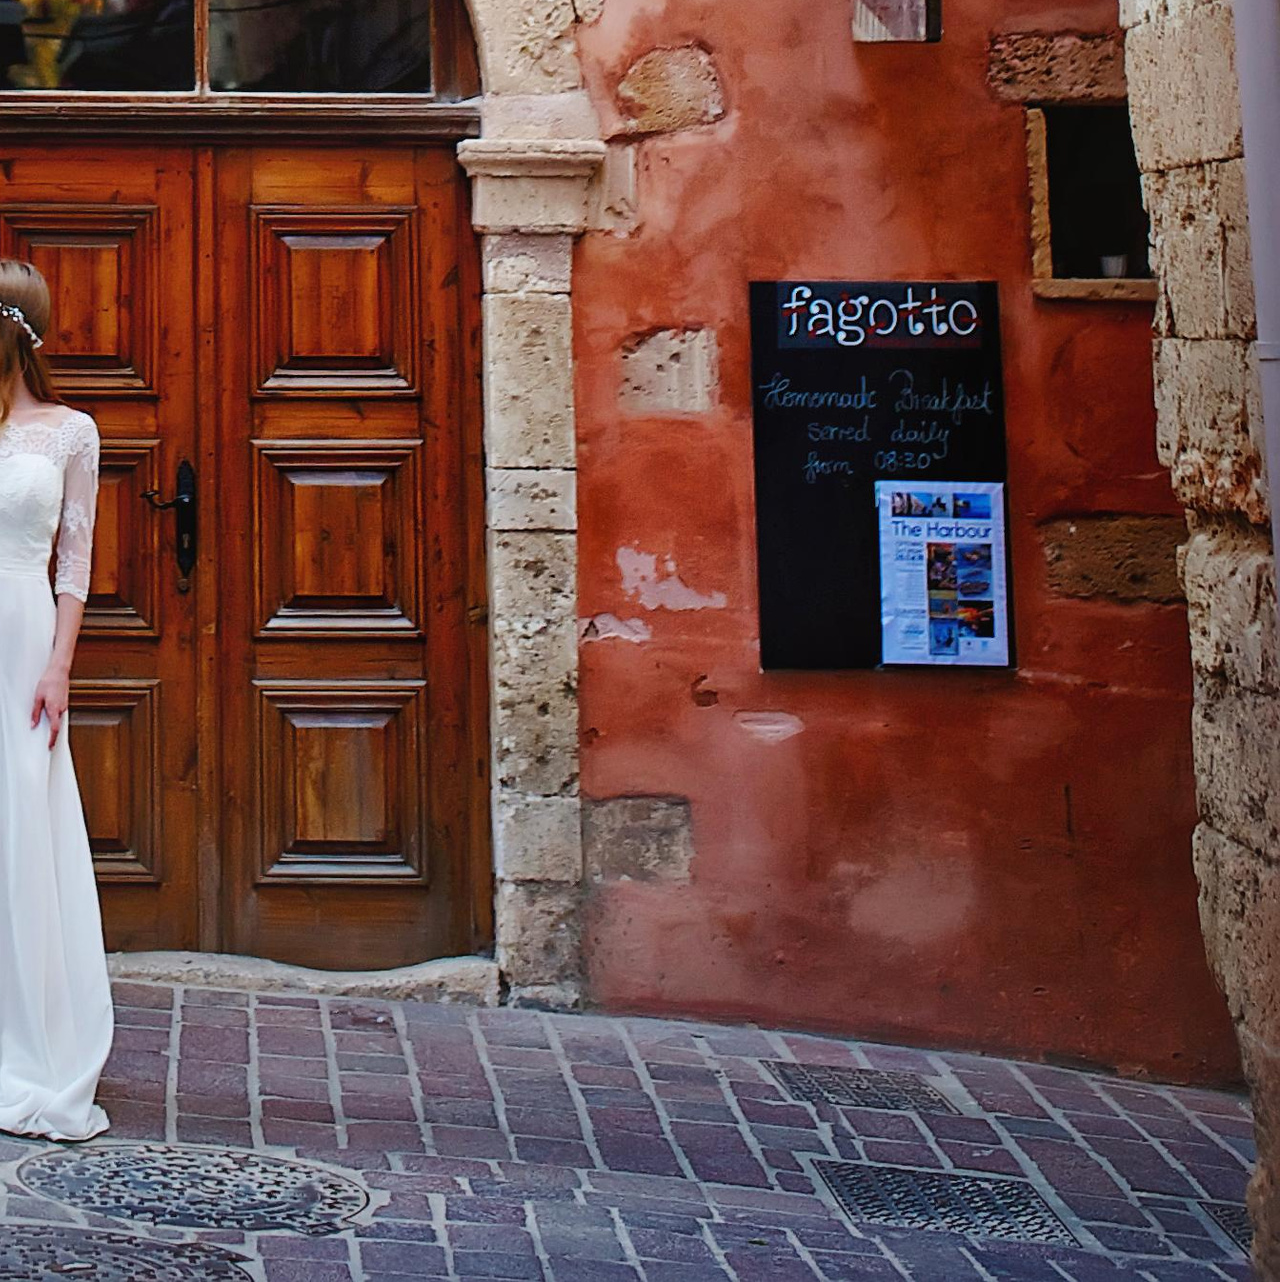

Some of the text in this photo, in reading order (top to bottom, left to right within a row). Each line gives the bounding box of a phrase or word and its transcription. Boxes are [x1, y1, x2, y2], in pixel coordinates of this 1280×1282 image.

[782, 285, 978, 346] fagotto
[758, 369, 993, 426] Homemade Breakfast
[807, 415, 950, 460] served daily
[802, 451, 854, 484] from
[892, 520, 992, 539] The Harbour
